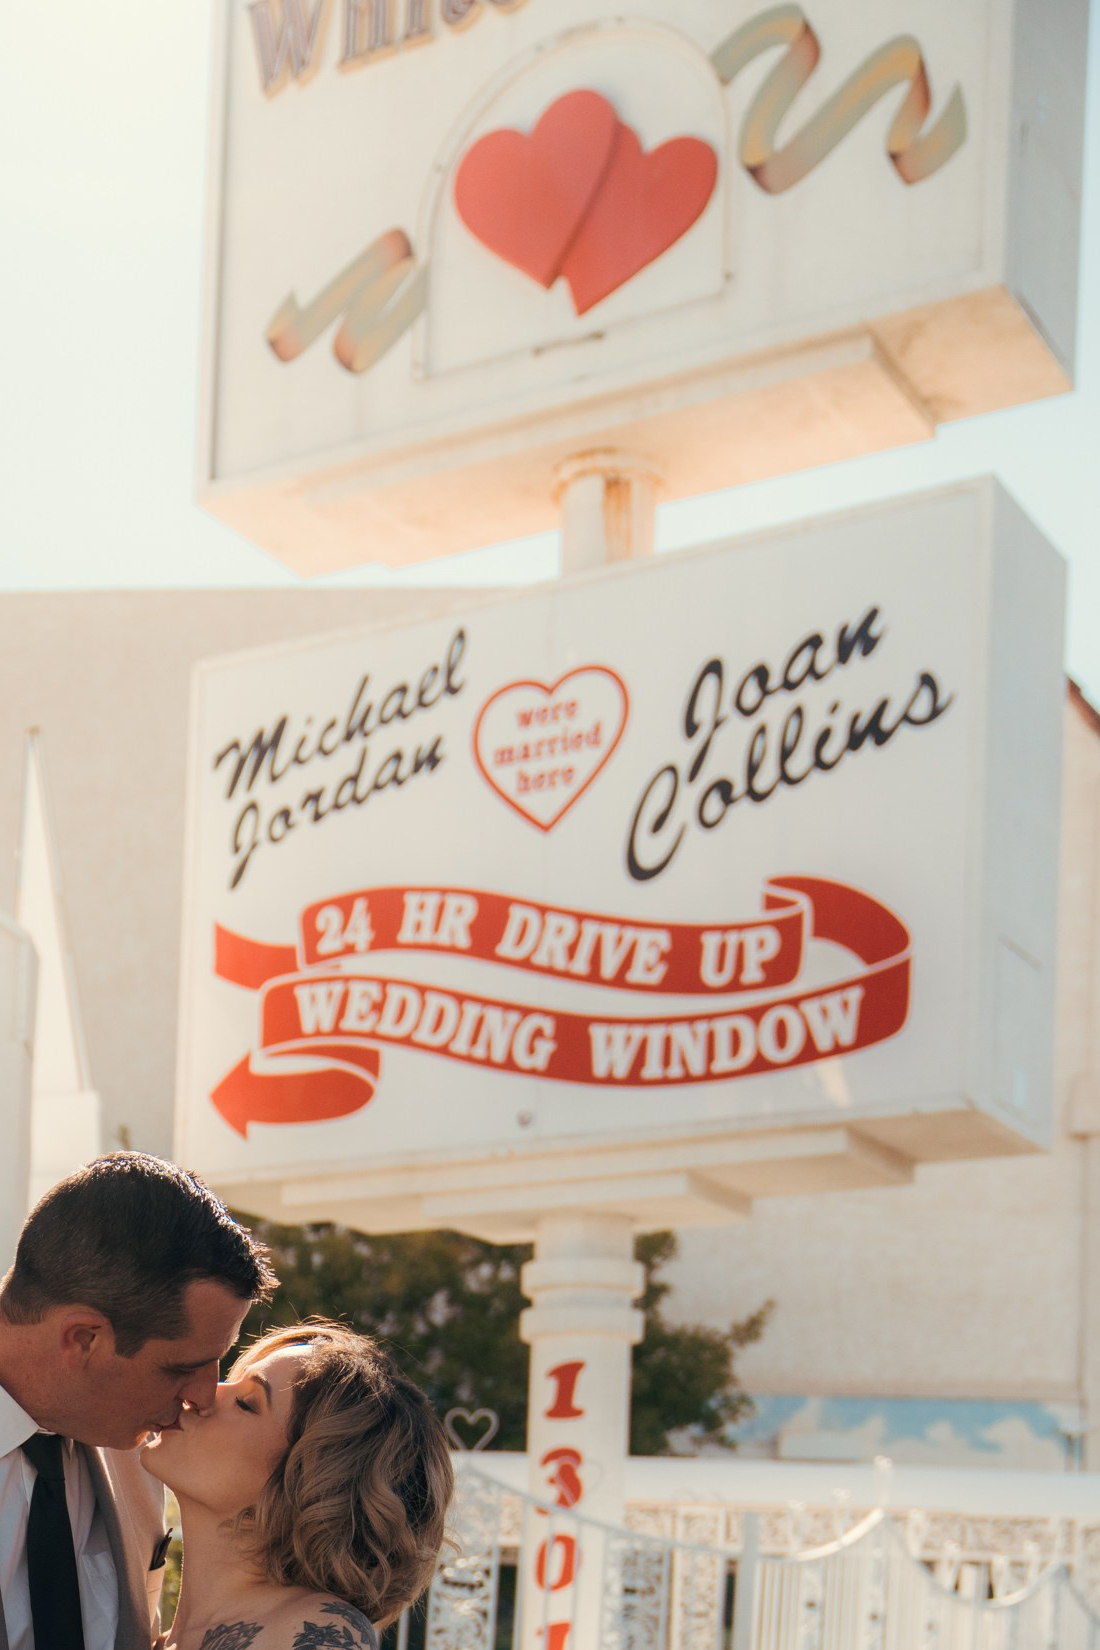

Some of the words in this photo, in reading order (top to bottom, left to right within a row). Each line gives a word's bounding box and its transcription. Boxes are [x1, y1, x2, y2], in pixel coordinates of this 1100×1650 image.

[213, 626, 467, 799] Michael
[493, 718, 604, 767] married
[516, 697, 580, 730] were
[683, 604, 886, 783] Joan
[230, 735, 444, 891] Jordan
[516, 765, 576, 795] here
[624, 671, 956, 883] Collins
[313, 904, 374, 955] 24
[396, 891, 480, 950] HR
[495, 904, 671, 986] DRIVE
[700, 924, 781, 987] UP
[293, 979, 557, 1072] WEDDING
[588, 986, 866, 1082] WINDOW
